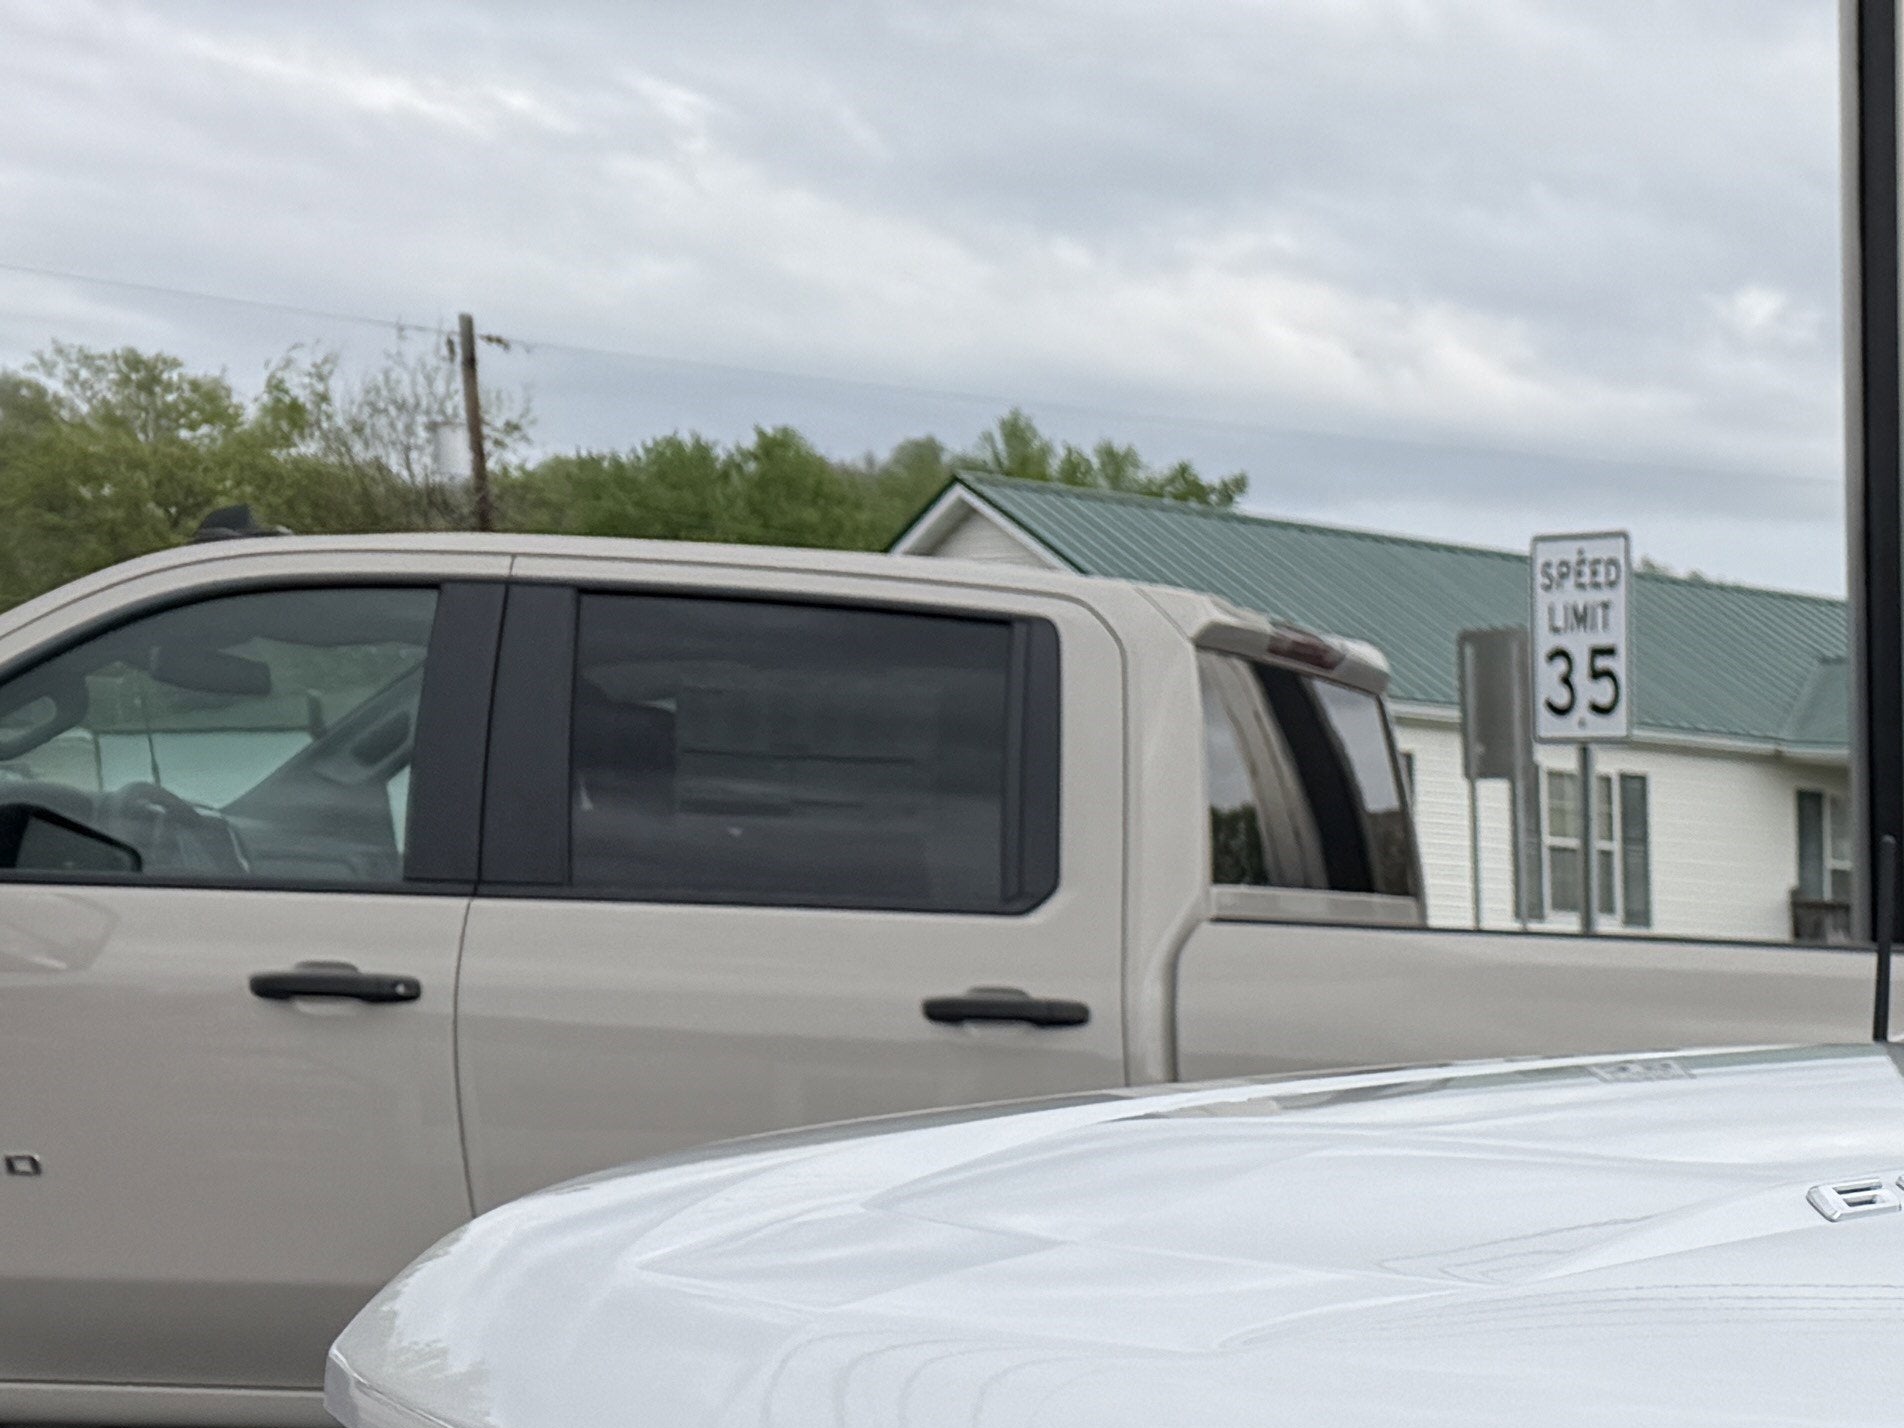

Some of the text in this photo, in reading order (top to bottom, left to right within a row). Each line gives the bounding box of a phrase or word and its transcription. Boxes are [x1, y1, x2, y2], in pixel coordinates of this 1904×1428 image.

[1539, 557, 1622, 592] SPEED
[1547, 600, 1612, 634] LIMIT
[1545, 645, 1620, 717] 35
